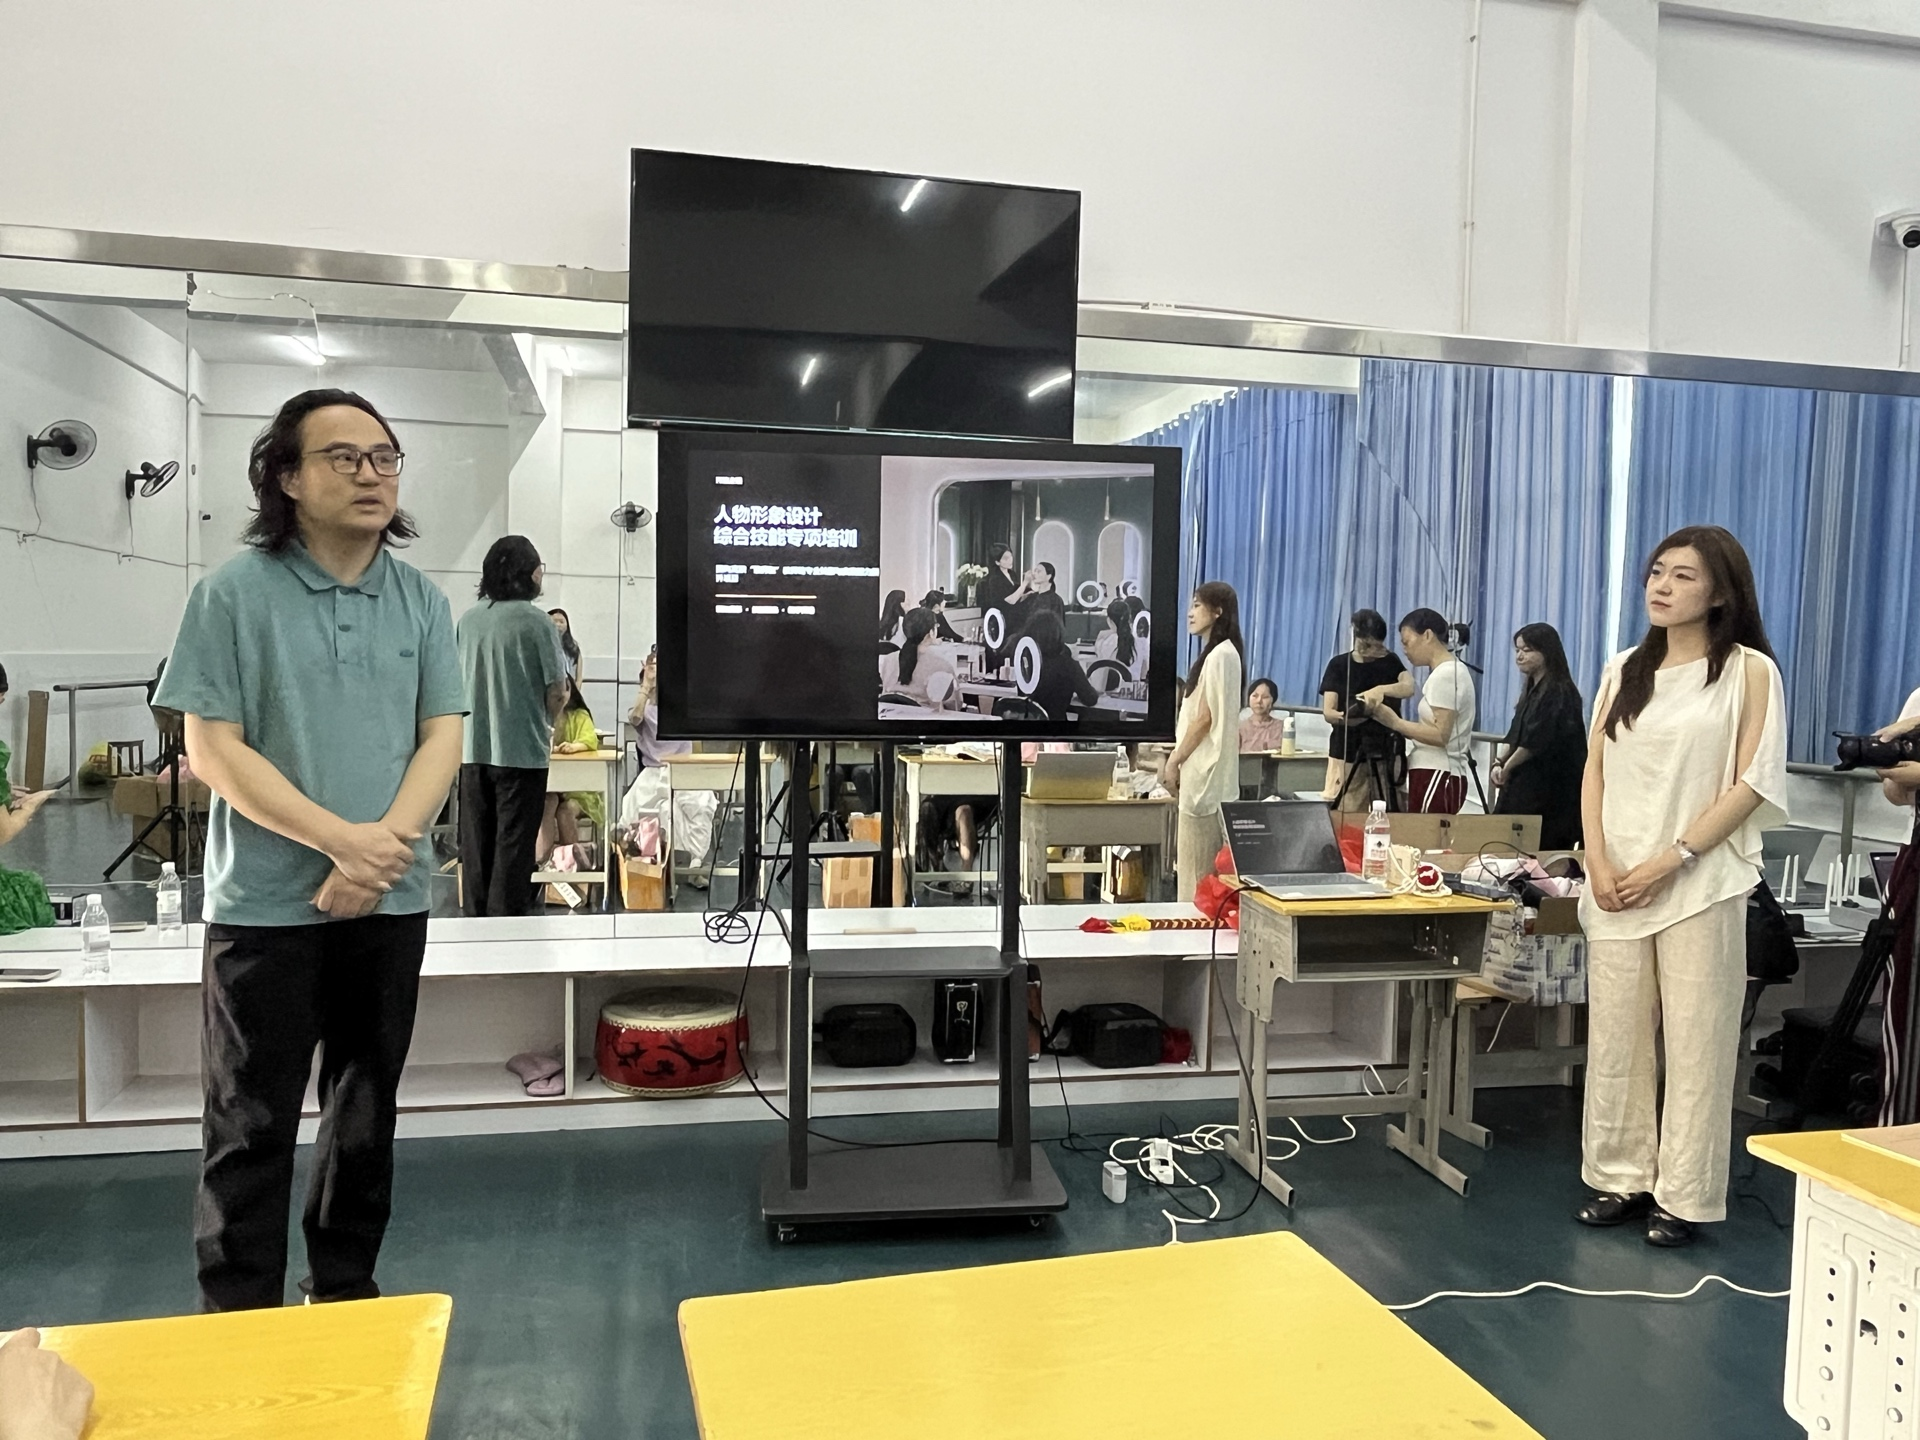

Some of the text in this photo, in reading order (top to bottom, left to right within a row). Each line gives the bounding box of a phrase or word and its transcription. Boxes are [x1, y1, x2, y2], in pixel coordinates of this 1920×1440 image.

[713, 503, 823, 526] 人物形象设计
[713, 525, 858, 548] 综合技能专项培训
